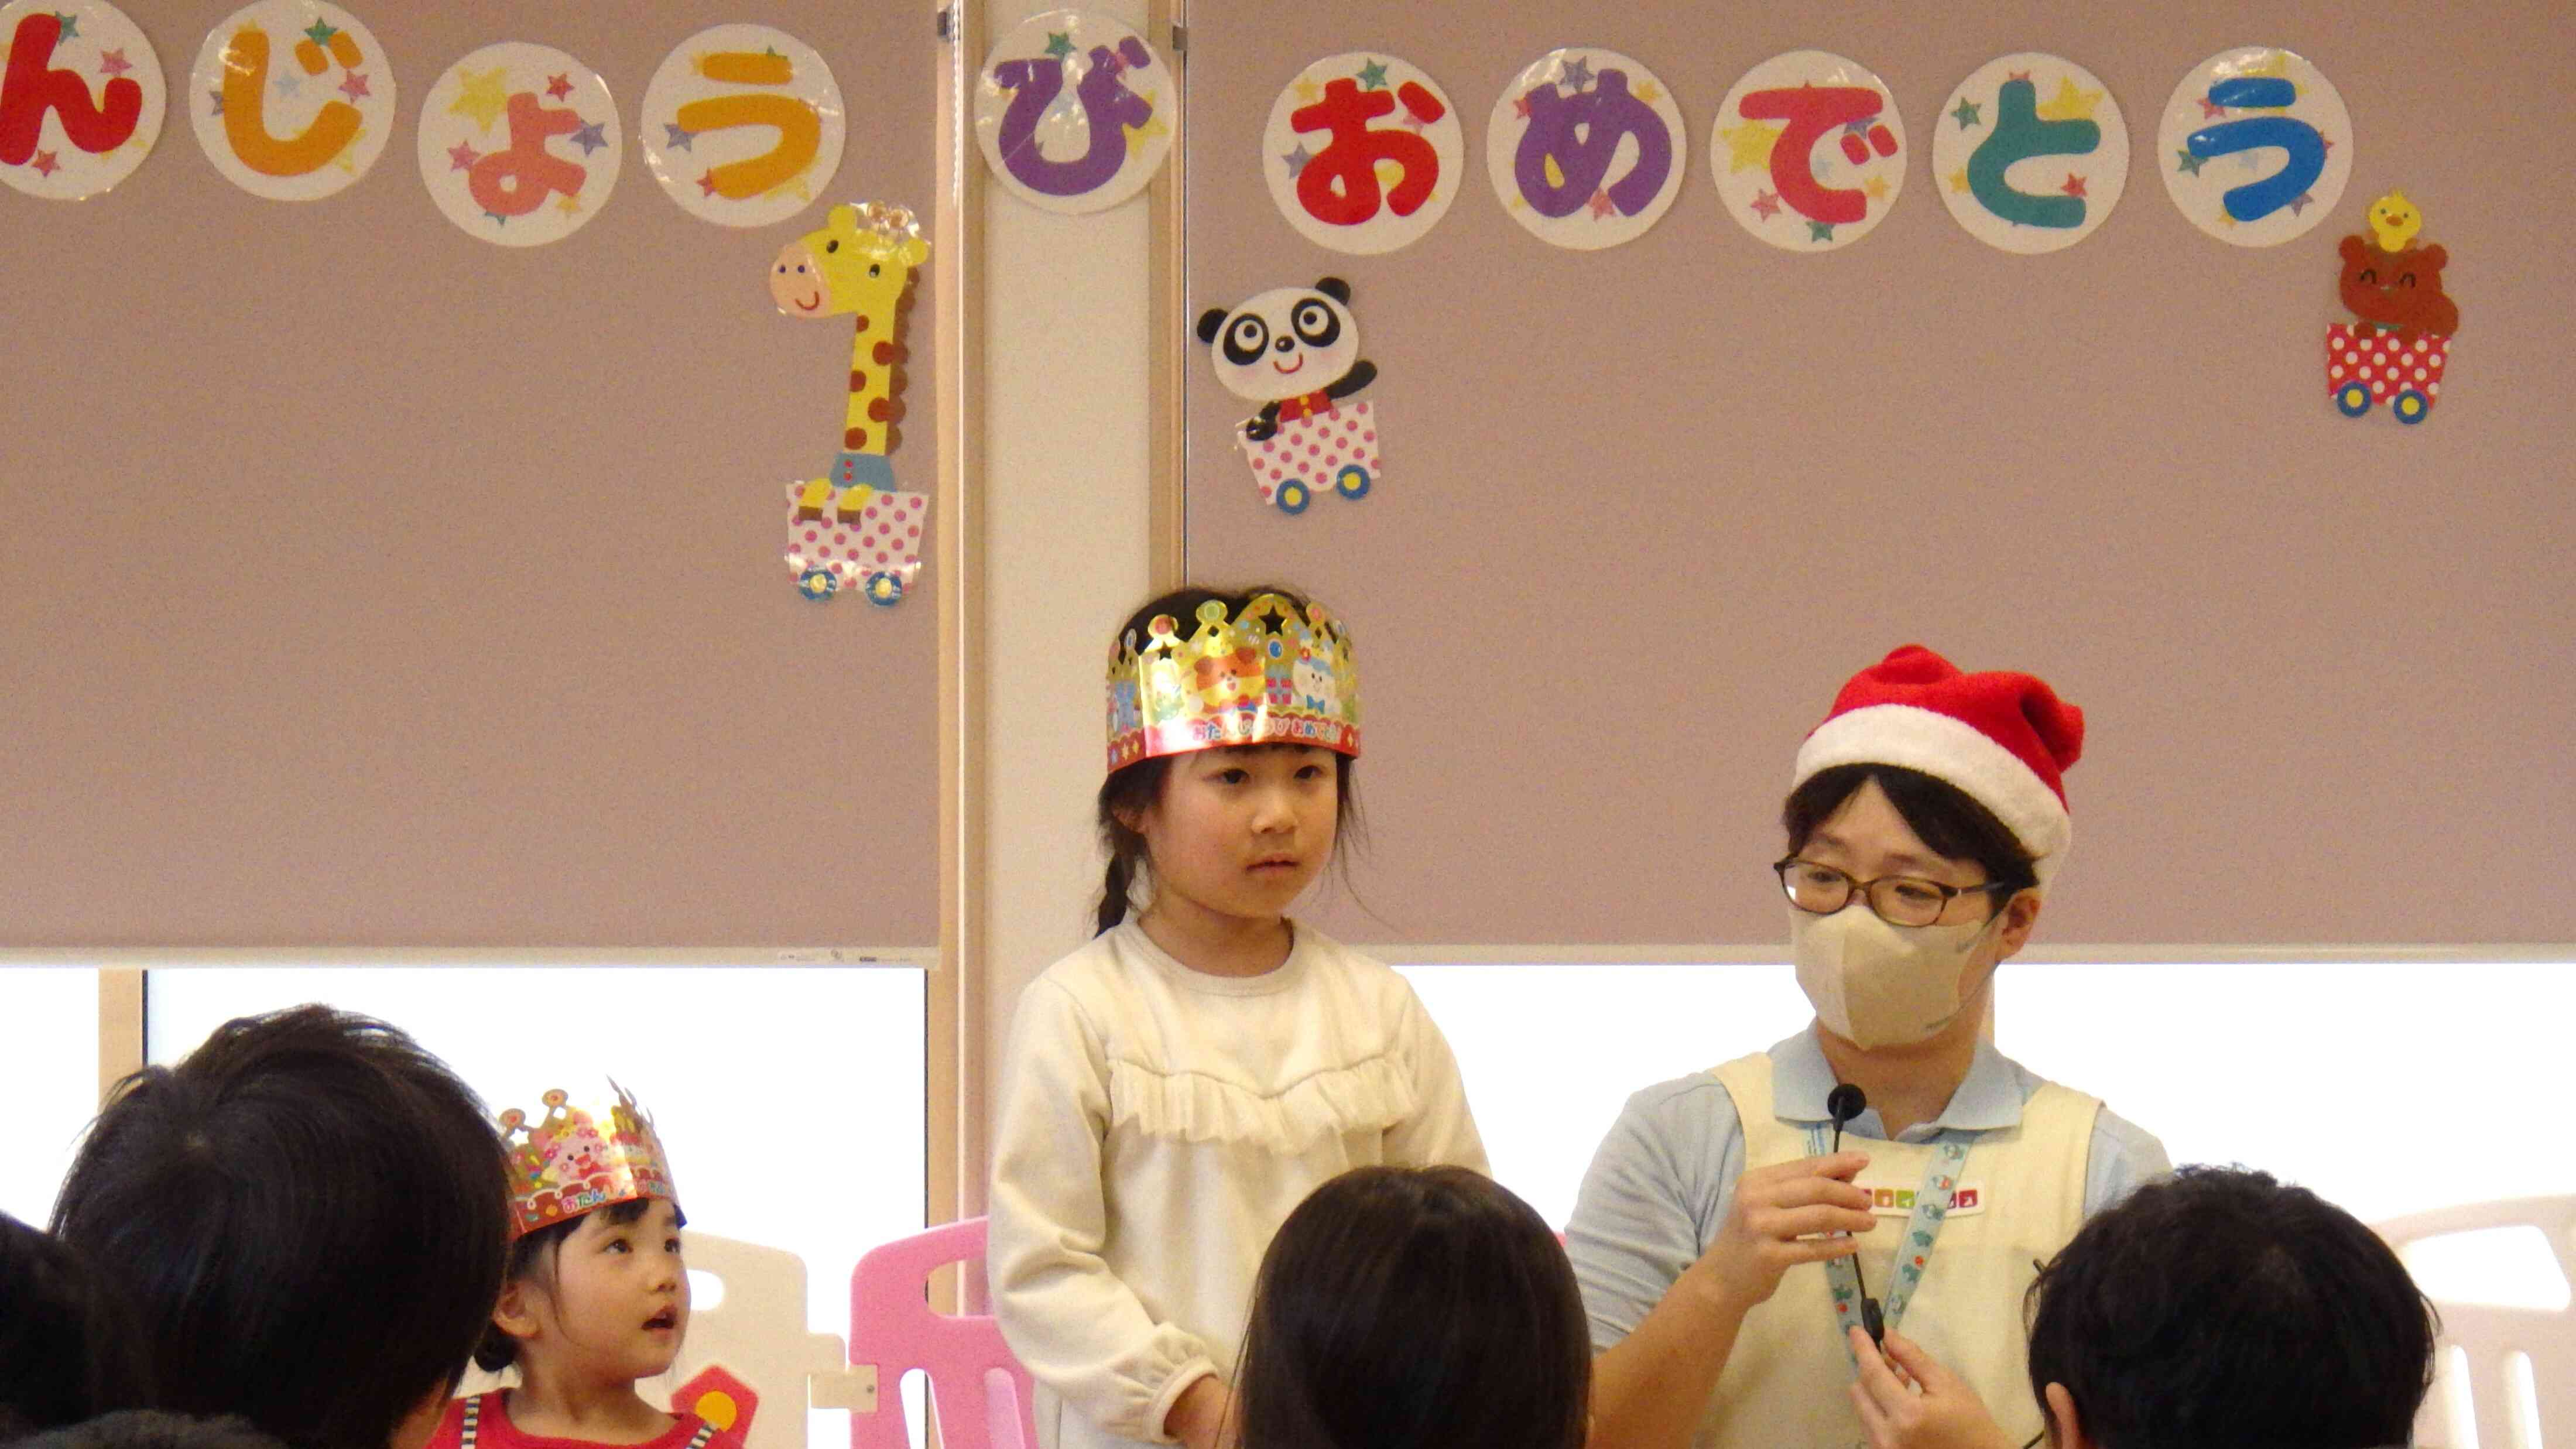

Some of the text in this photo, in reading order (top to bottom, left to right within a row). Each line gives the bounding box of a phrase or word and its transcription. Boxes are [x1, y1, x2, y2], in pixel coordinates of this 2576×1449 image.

[1291, 69, 2327, 226] おめでとう
